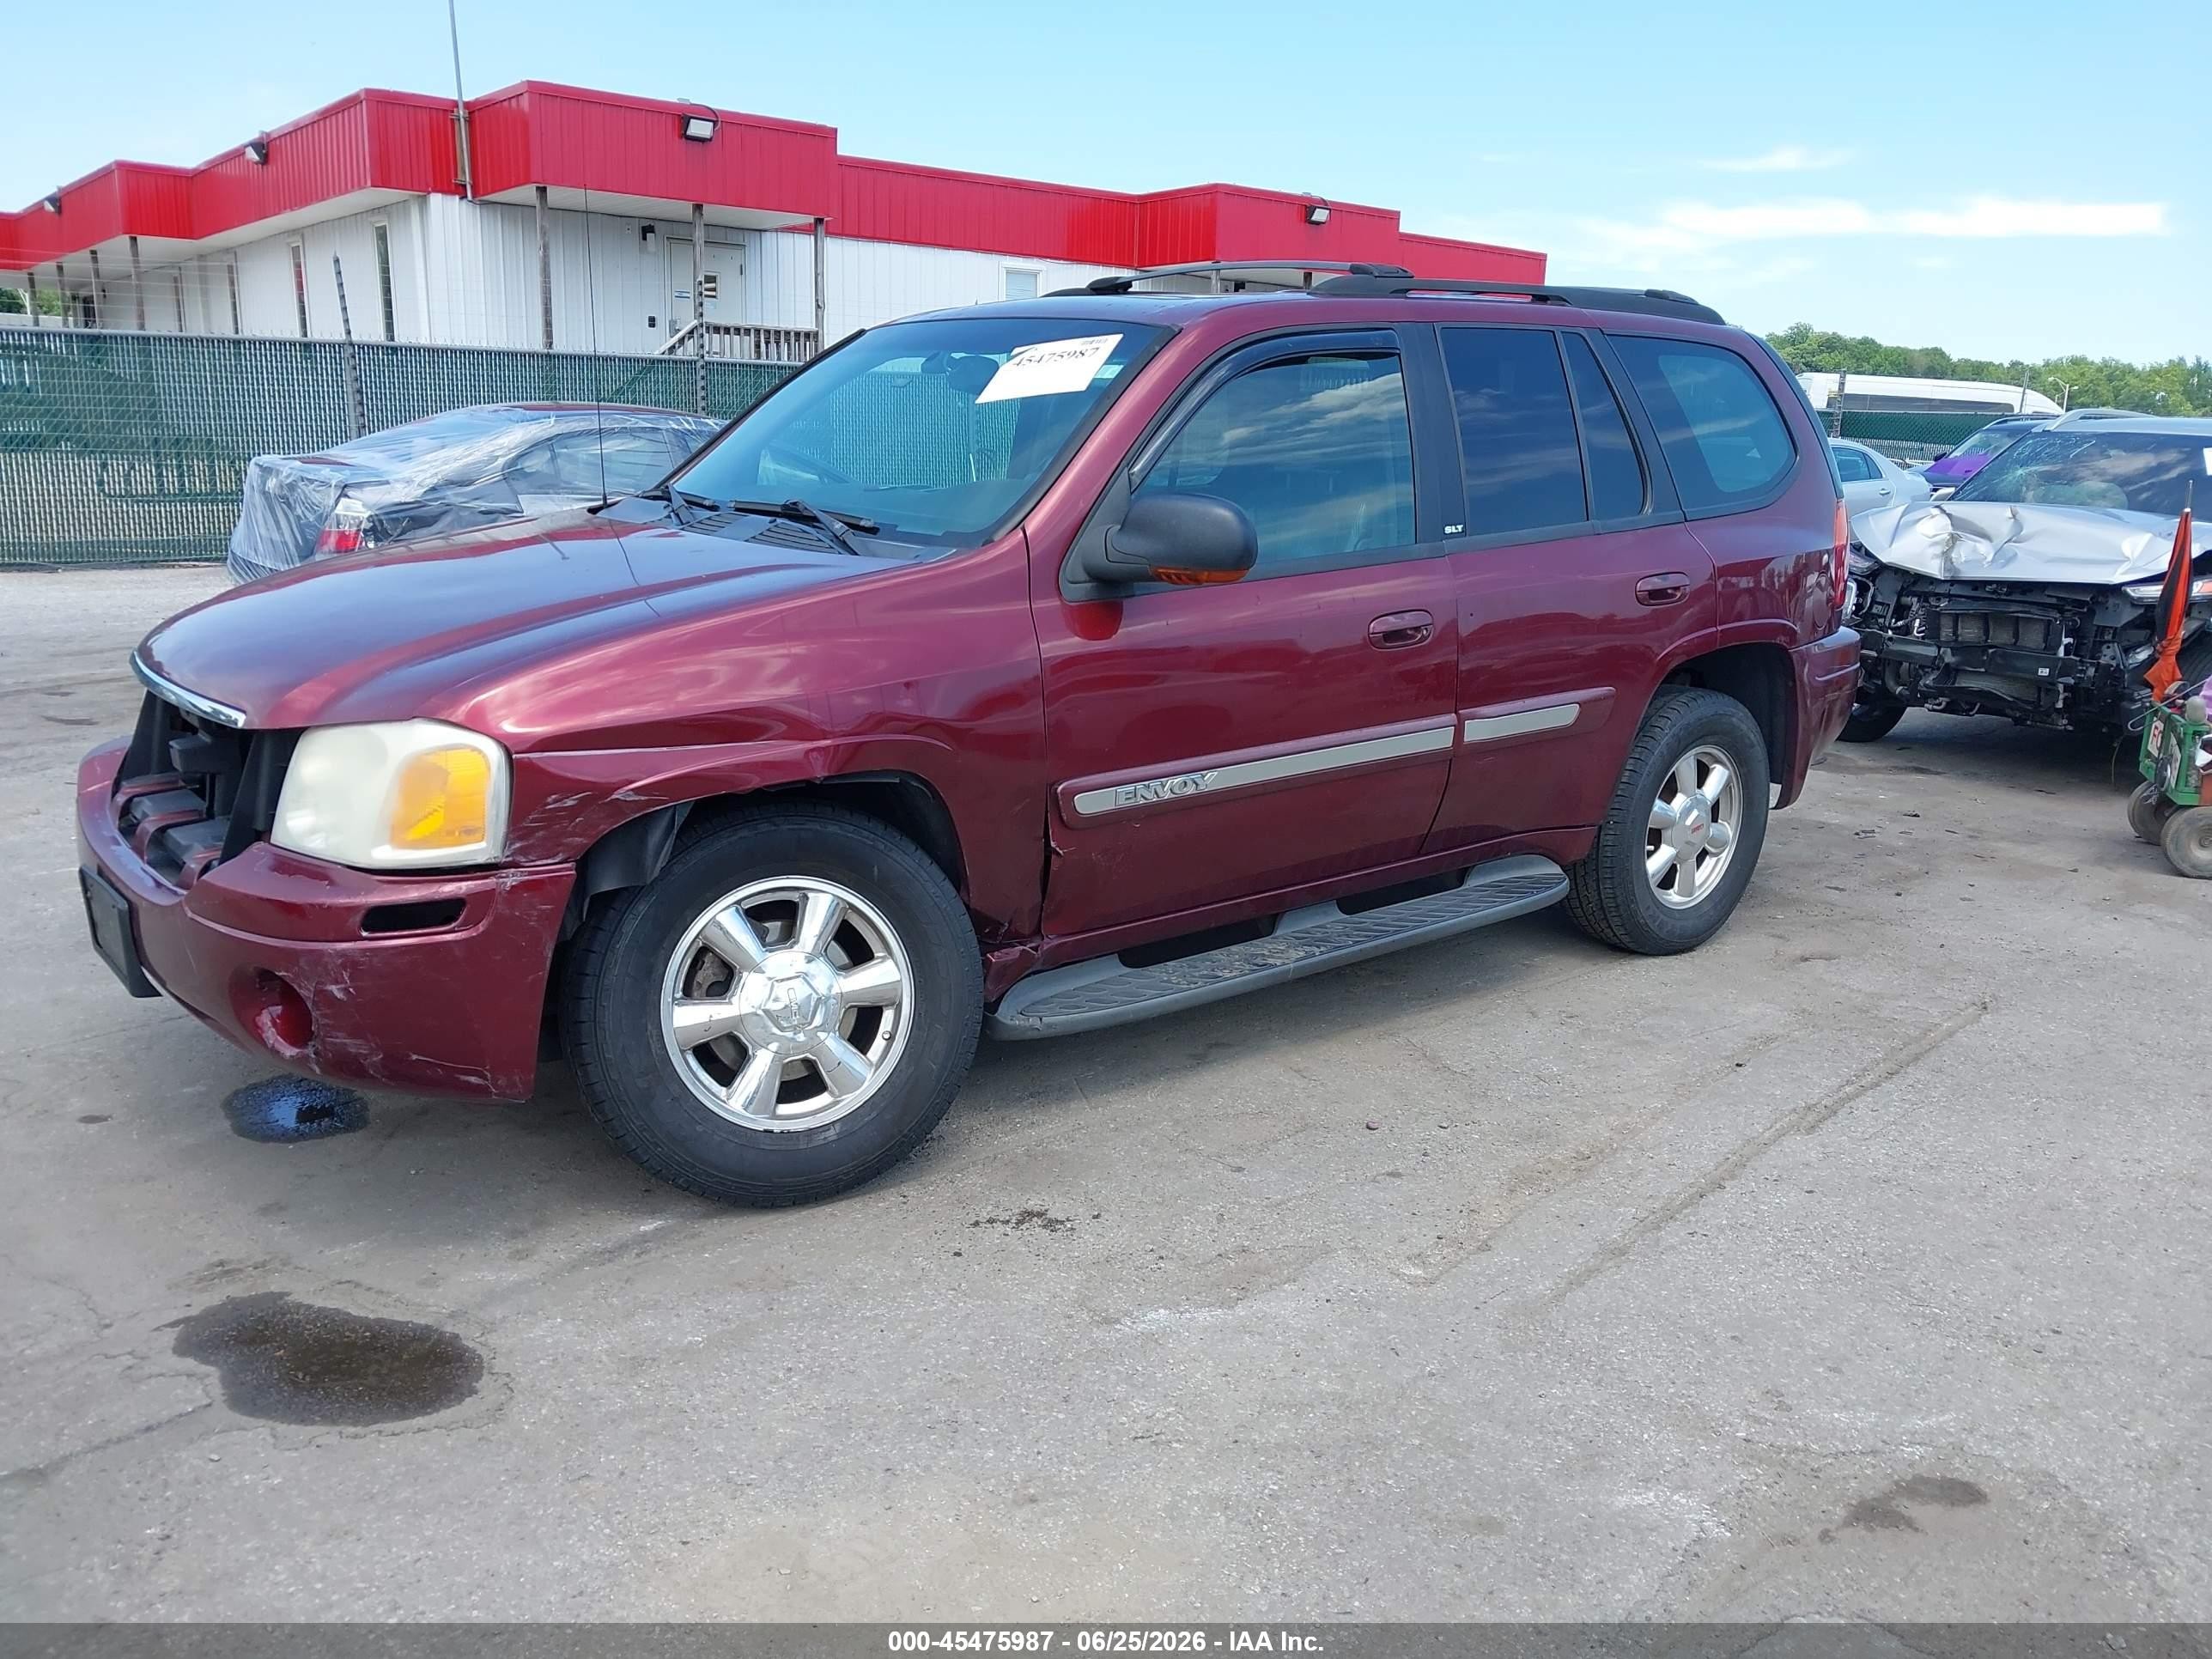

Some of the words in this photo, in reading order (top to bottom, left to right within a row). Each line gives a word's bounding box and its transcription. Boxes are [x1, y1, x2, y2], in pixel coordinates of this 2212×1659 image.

[1012, 346, 1101, 368] 45475987
[1444, 525, 1464, 534] SLT
[1115, 771, 1218, 806] ENVOY
